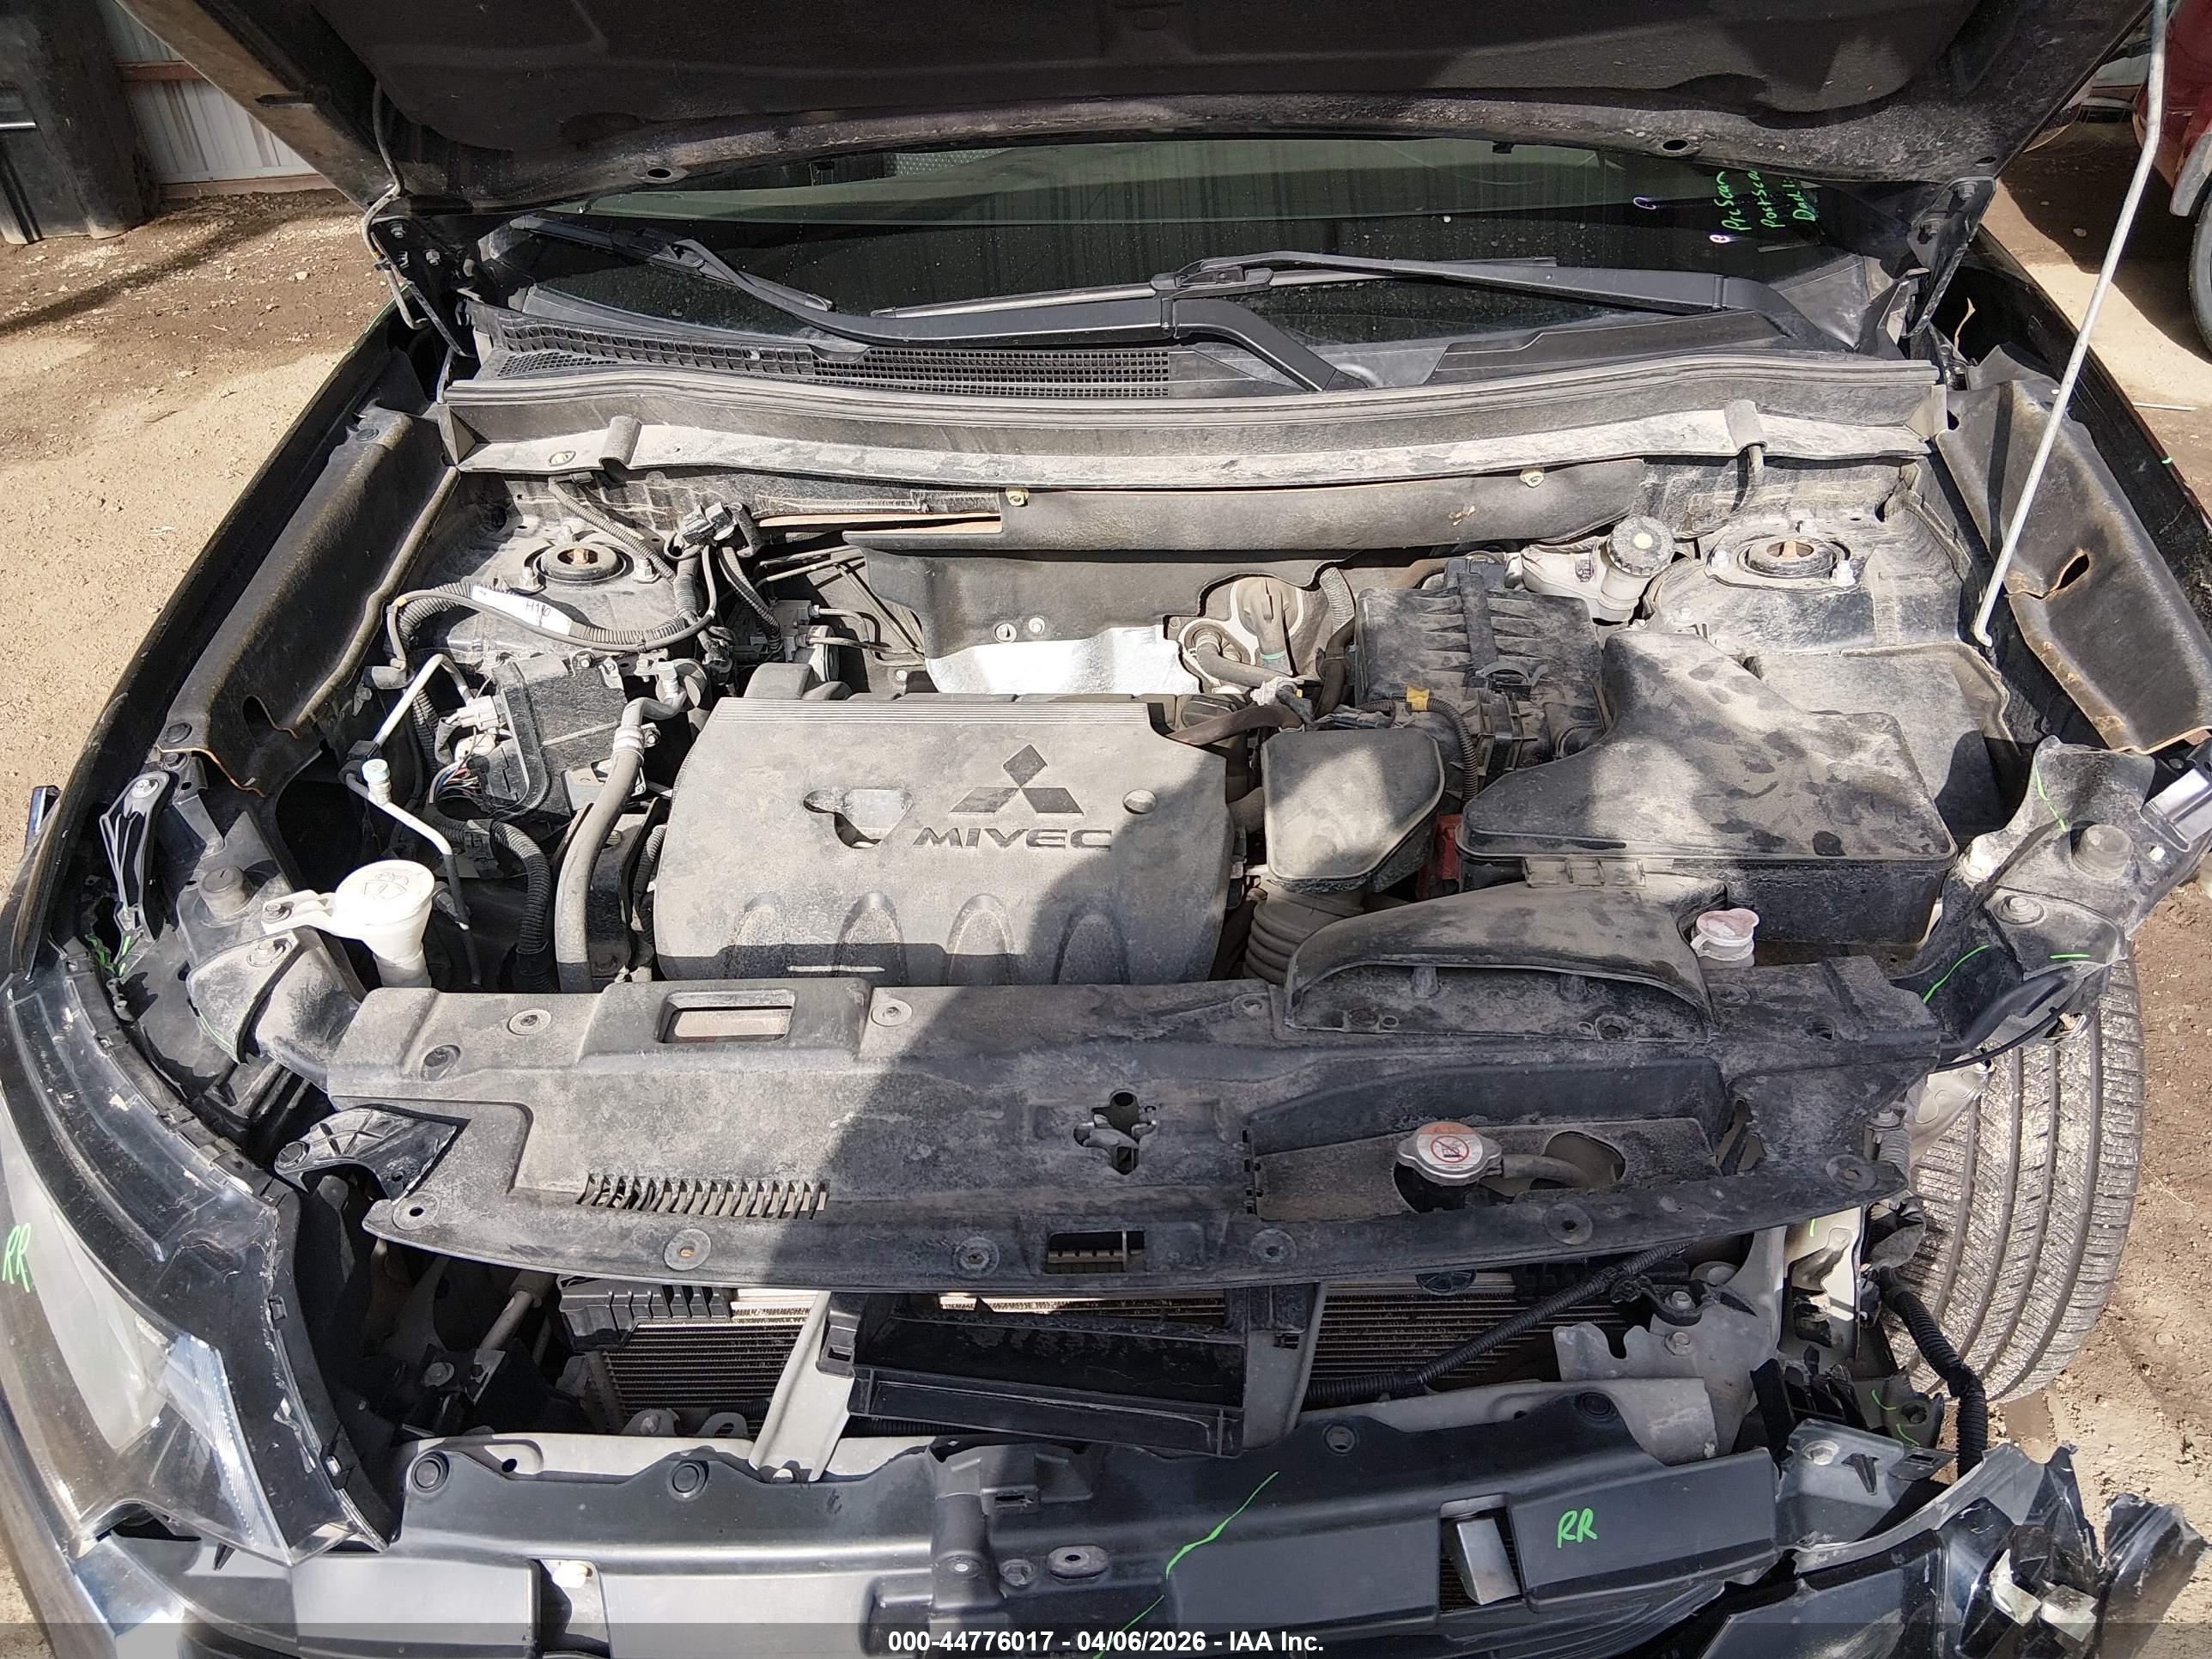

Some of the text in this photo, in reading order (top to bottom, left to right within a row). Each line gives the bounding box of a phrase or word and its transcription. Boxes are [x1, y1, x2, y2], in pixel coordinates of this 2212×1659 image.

[913, 826, 1113, 851] MIVEC
[2, 1222, 32, 1293] RR
[1557, 1508, 1598, 1549] RR
